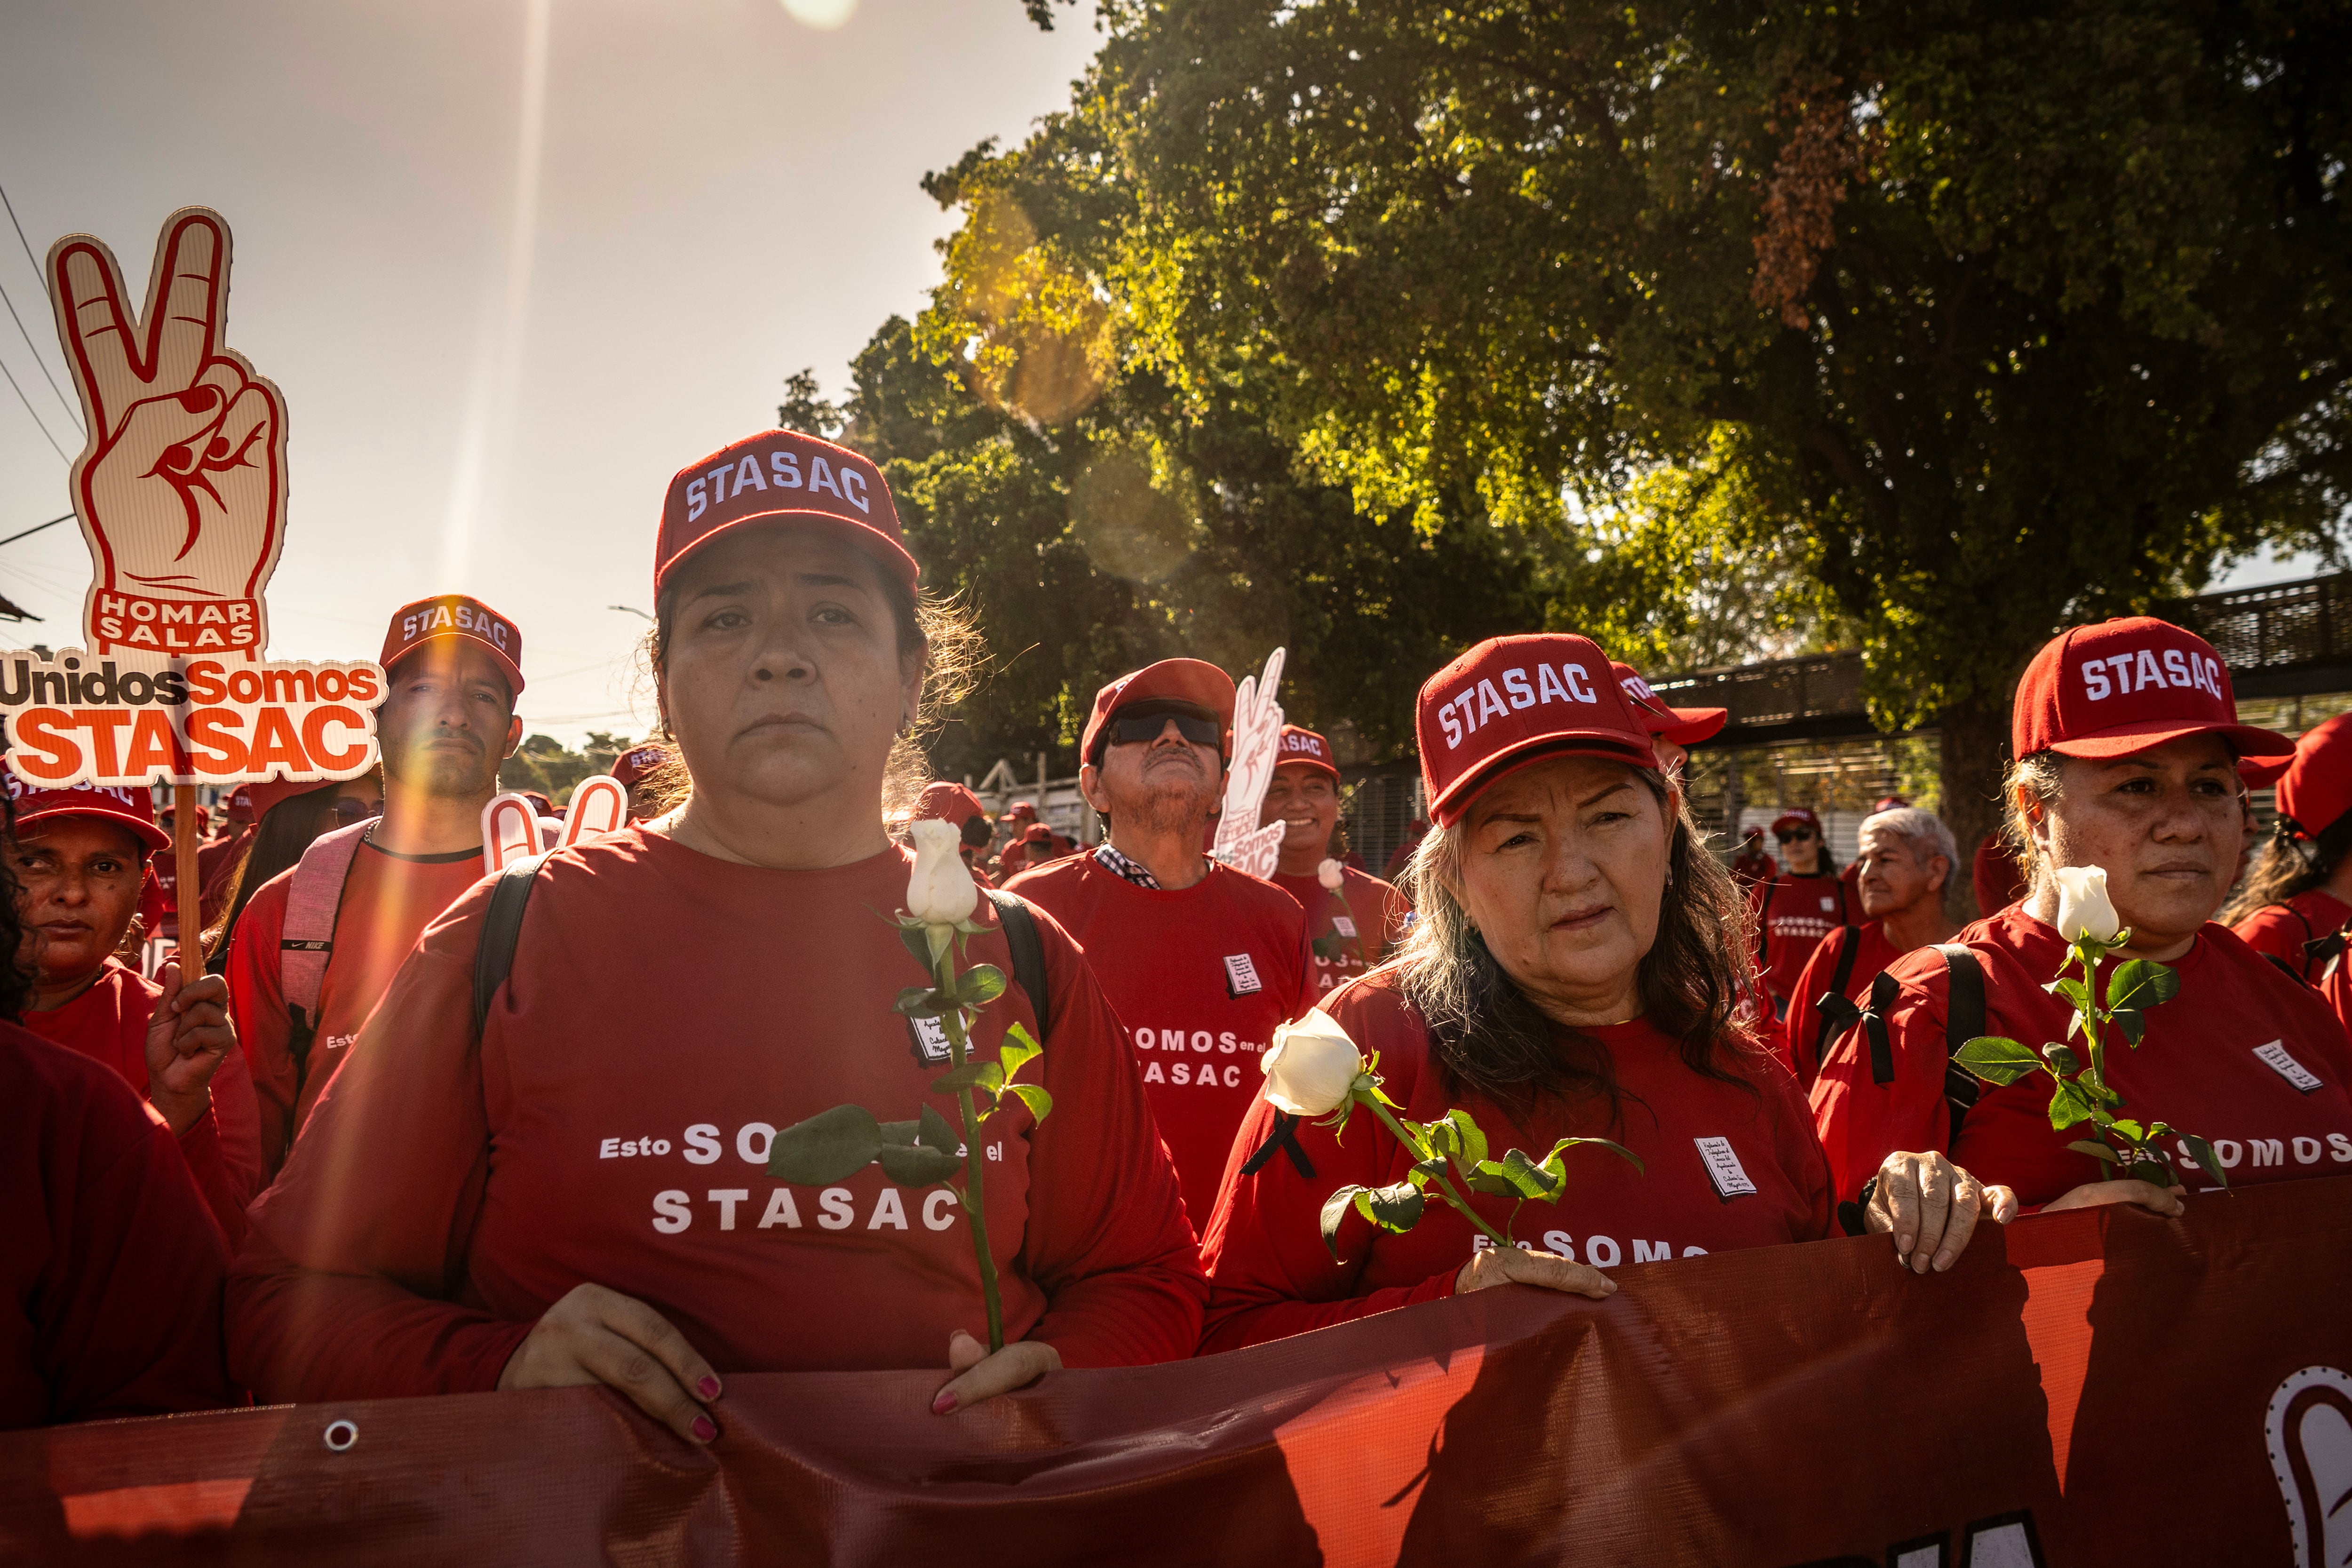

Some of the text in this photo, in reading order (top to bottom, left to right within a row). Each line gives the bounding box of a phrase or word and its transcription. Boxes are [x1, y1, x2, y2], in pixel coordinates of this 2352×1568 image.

[686, 451, 869, 522] STASAC
[101, 594, 252, 625] HOMAR
[100, 617, 254, 648] SALAS
[404, 605, 507, 651] STASAC
[2082, 649, 2221, 700] STASAC
[1438, 663, 1597, 749] STASAC
[16, 705, 368, 780] STASAC
[1279, 734, 1322, 757] ASAC
[1124, 1026, 1266, 1054] OMOS en el
[1137, 1061, 1241, 1087] ASAC
[599, 1135, 671, 1159] Esto
[986, 1141, 1002, 1162] el
[2177, 1133, 2352, 1169] SOMOS
[652, 1187, 958, 1234] STASAC
